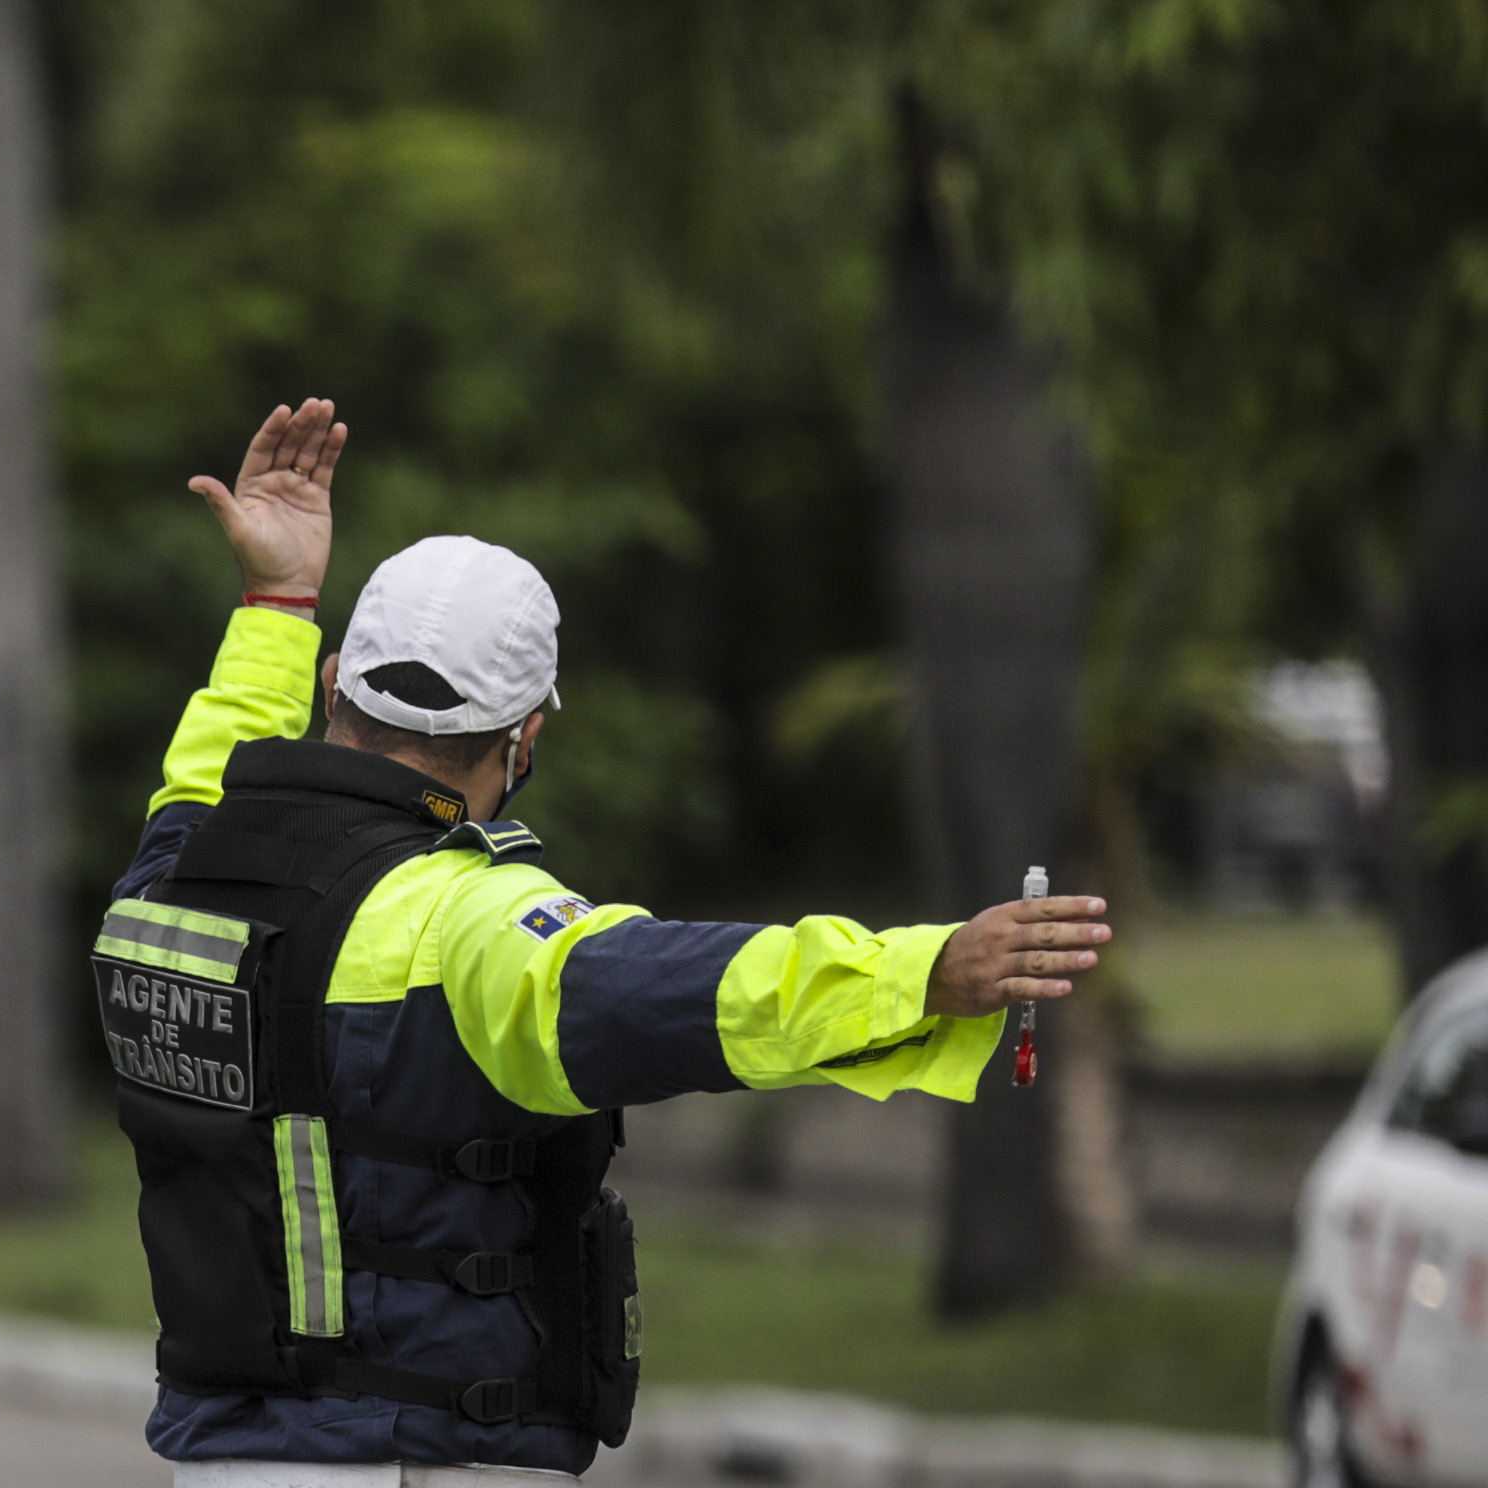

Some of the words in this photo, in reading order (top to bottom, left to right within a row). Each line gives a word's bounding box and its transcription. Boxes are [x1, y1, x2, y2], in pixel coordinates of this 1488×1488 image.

[425, 796, 458, 822] GMR
[109, 969, 233, 1034] AGENTE
[151, 1019, 179, 1048] DE
[108, 1032, 245, 1101] TRÂNSITO
